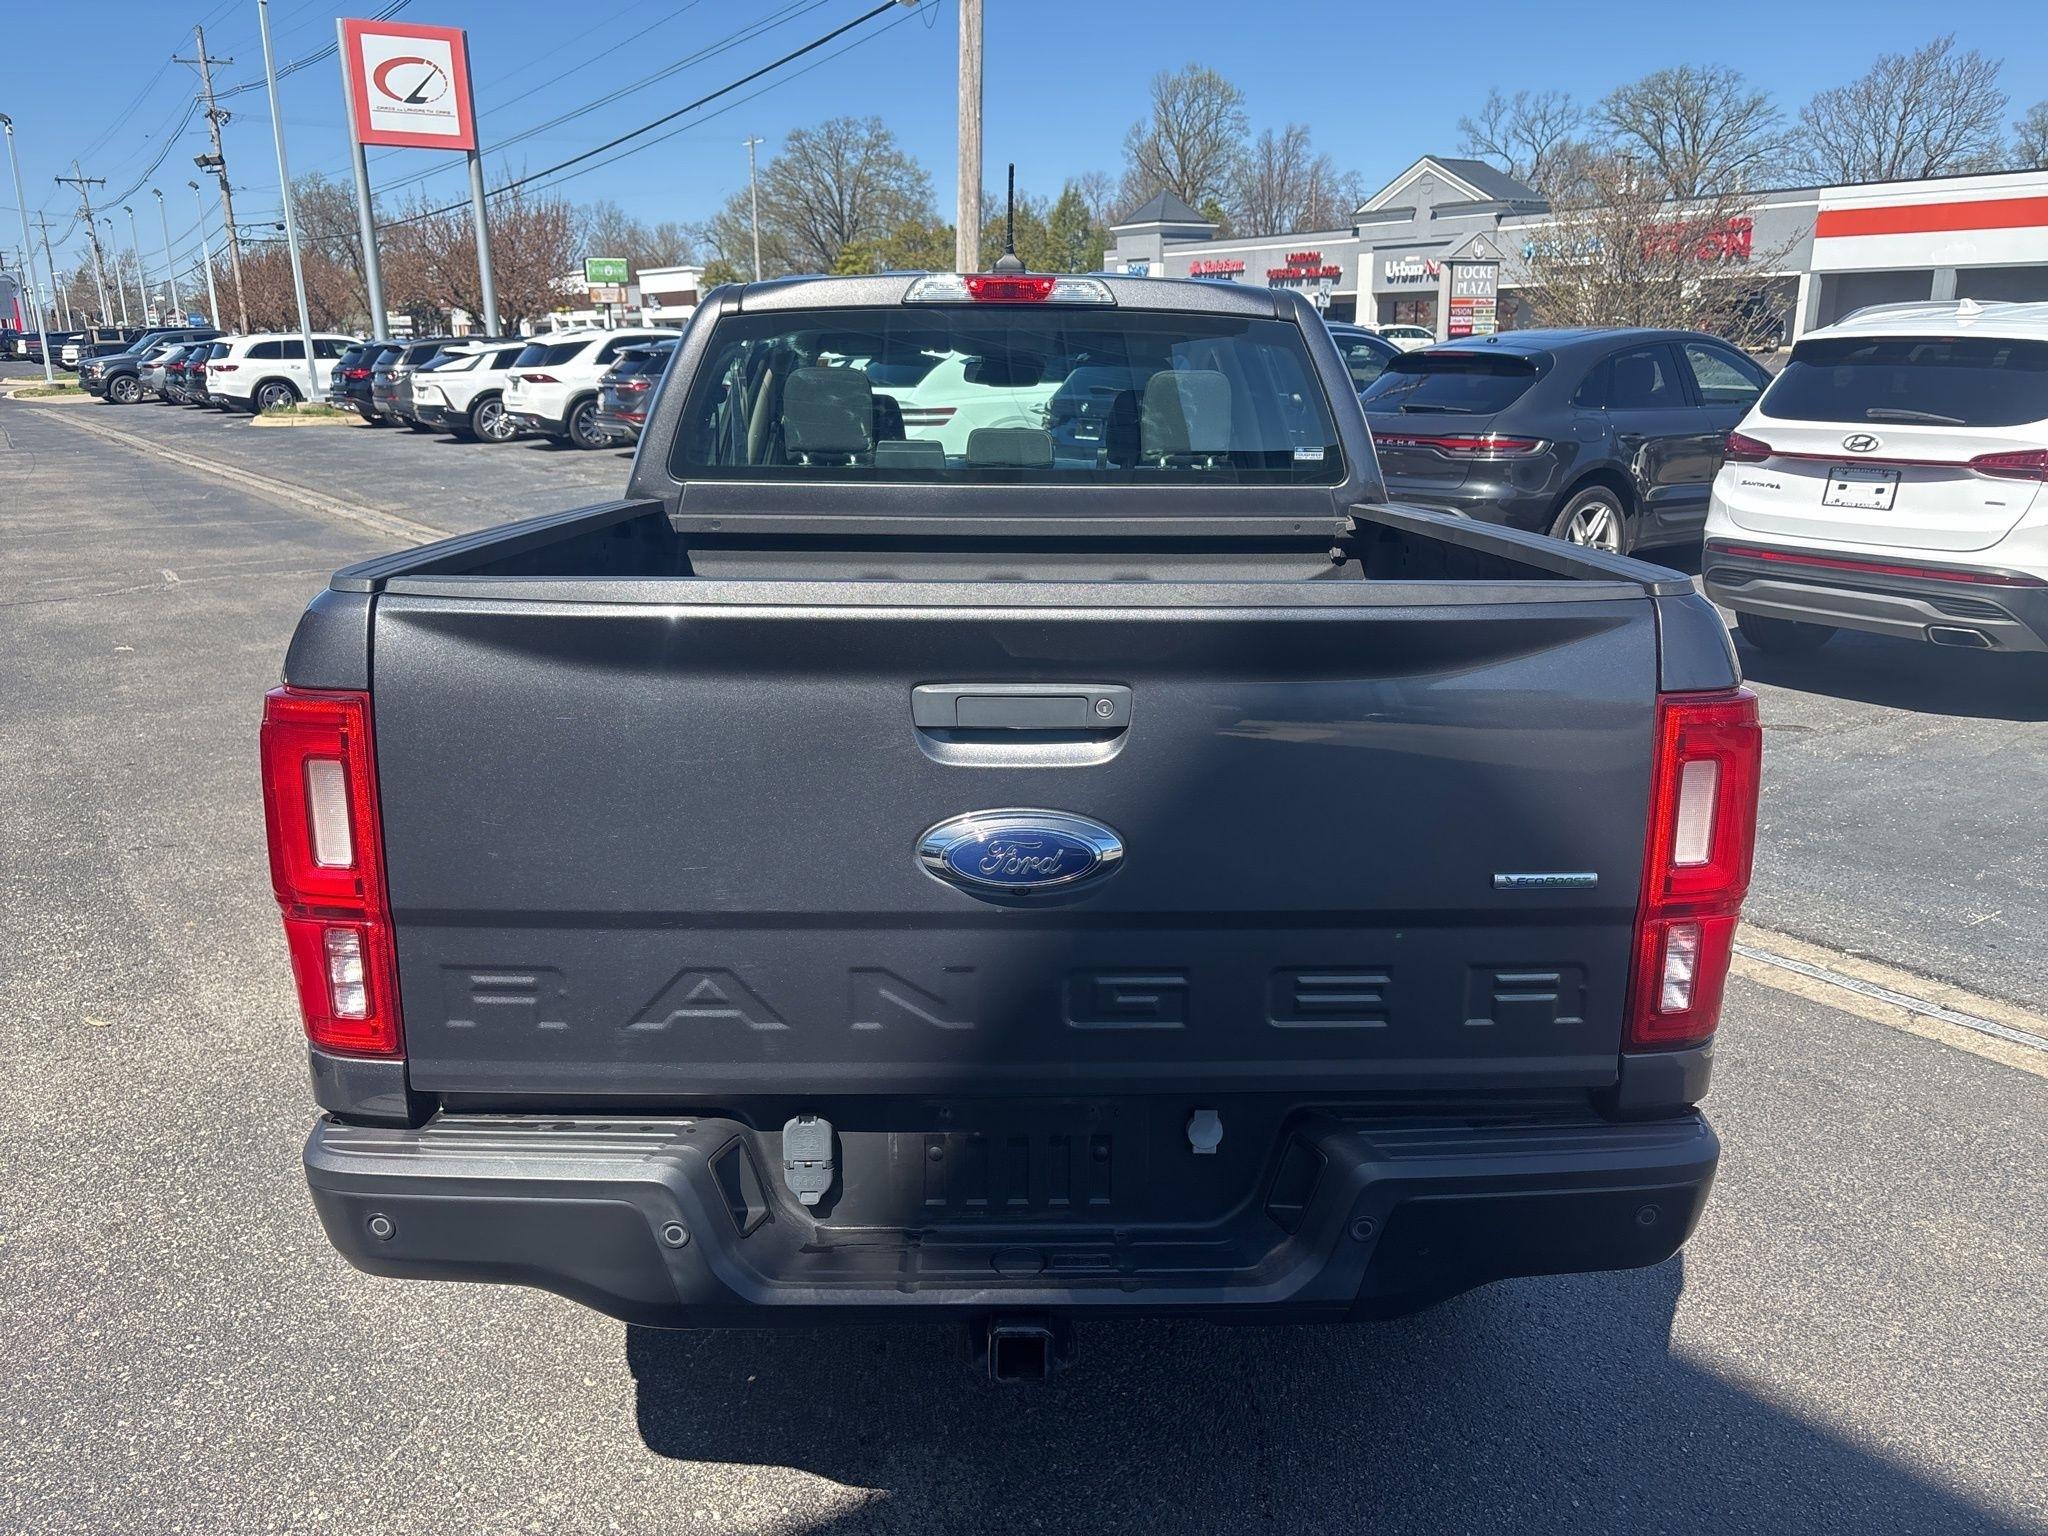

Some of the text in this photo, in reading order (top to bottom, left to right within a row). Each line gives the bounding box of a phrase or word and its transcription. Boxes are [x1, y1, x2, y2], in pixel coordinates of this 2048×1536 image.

[1385, 261, 1424, 277] Urban
[1458, 265, 1493, 279] LOCKE
[1457, 281, 1492, 295] PLAZA
[979, 840, 1063, 875] Ford
[440, 963, 1588, 1030] RANGER
